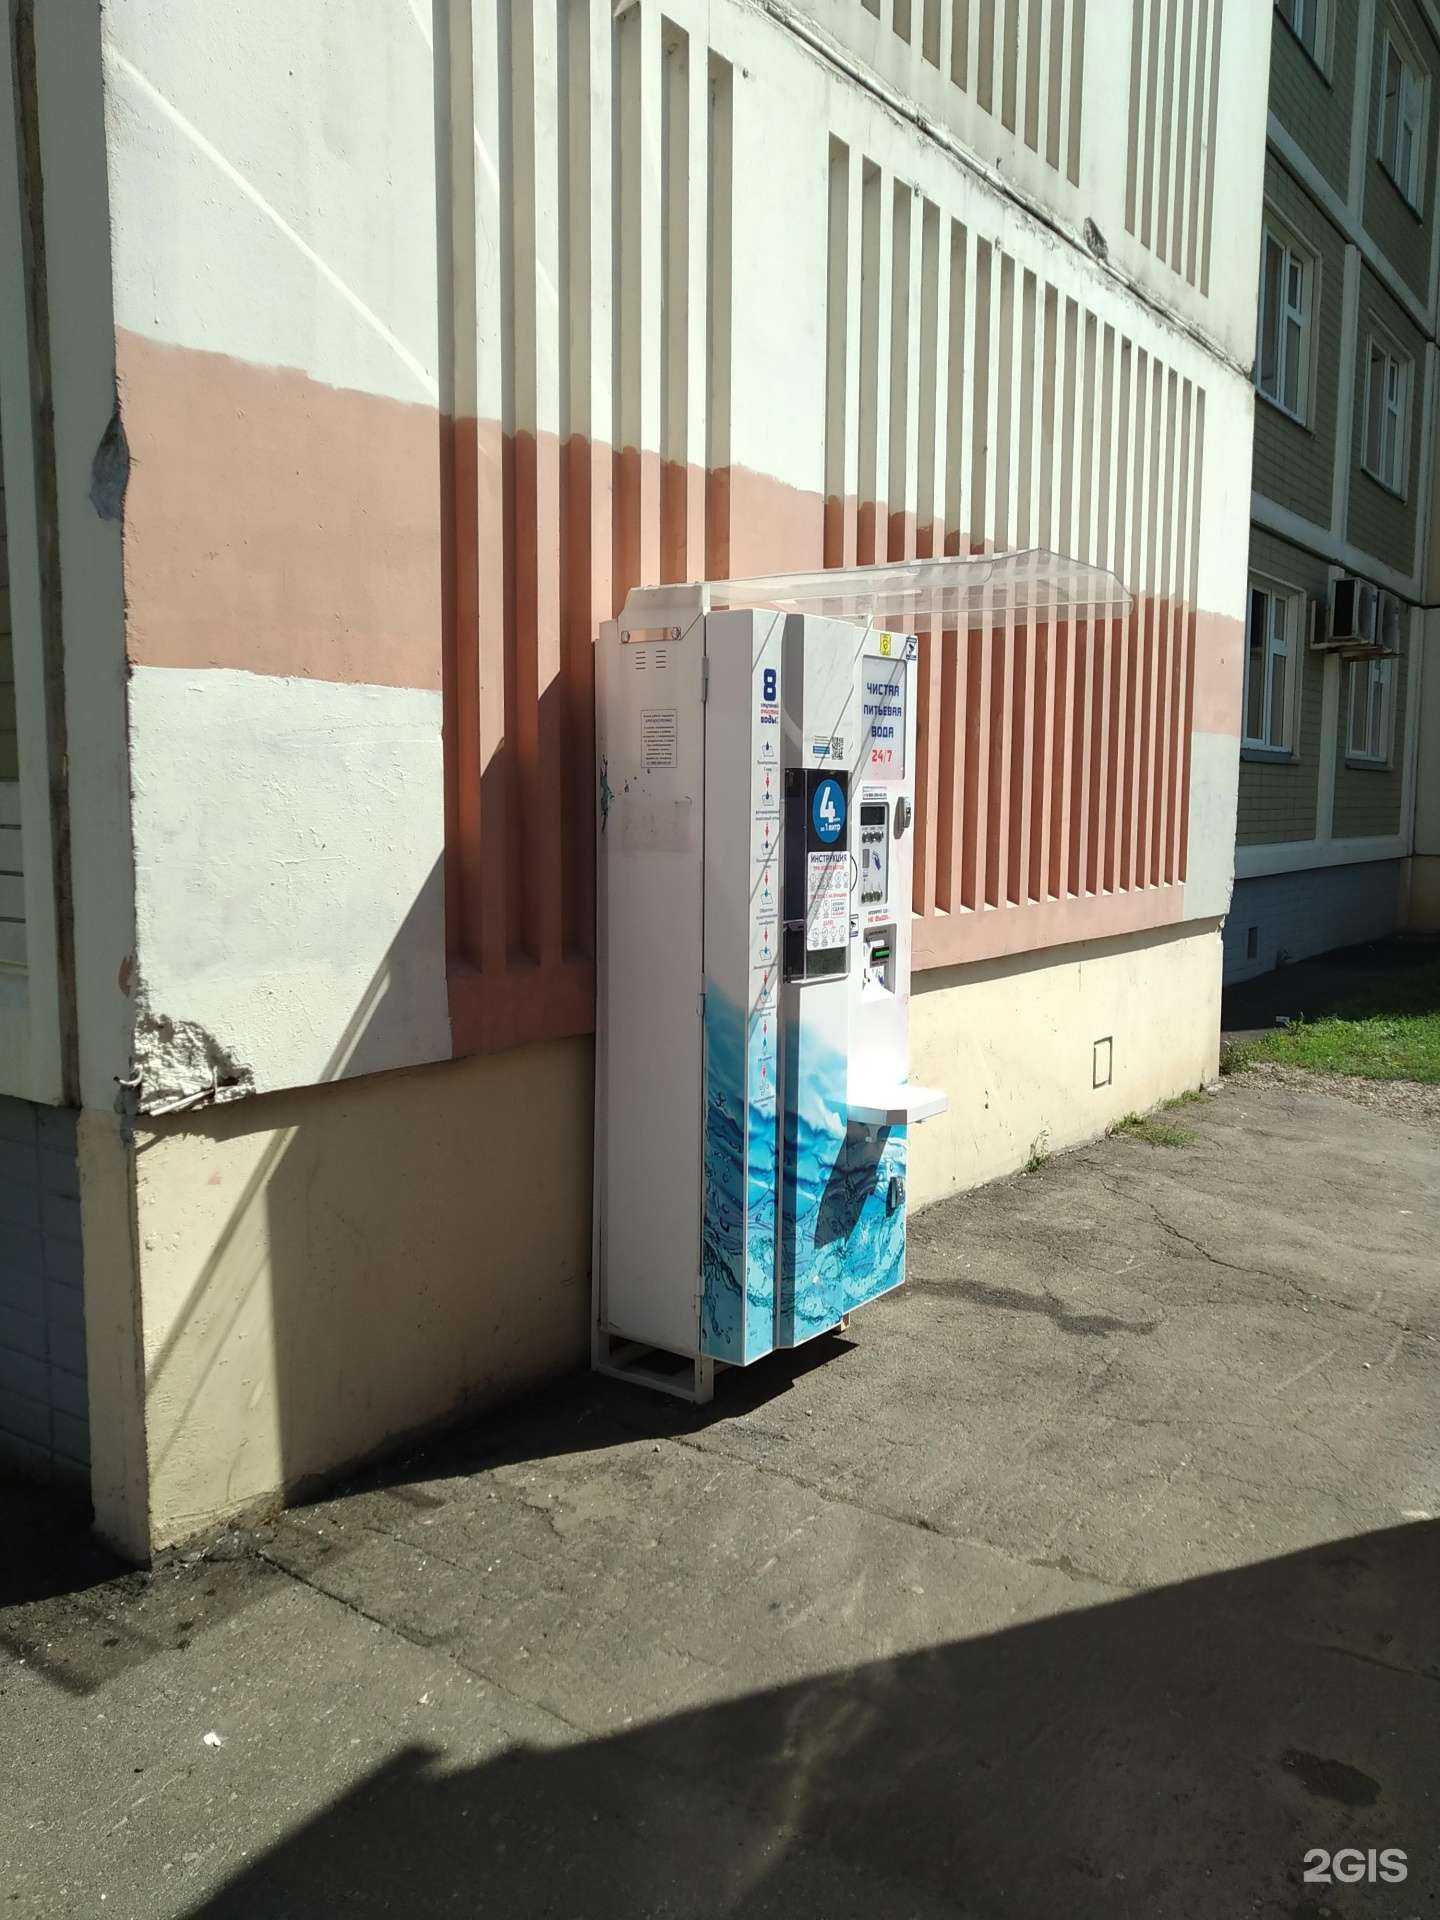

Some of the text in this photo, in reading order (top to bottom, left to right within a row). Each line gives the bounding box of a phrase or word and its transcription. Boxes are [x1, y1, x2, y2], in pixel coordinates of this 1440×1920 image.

[764, 668, 776, 701] 8
[867, 682, 899, 697] ЧИСТАЯ
[863, 704, 902, 717] ПИТЬЕВАЯ
[871, 725, 894, 739] ВОДА
[871, 749, 893, 764] 24/7
[820, 786, 836, 823] 4
